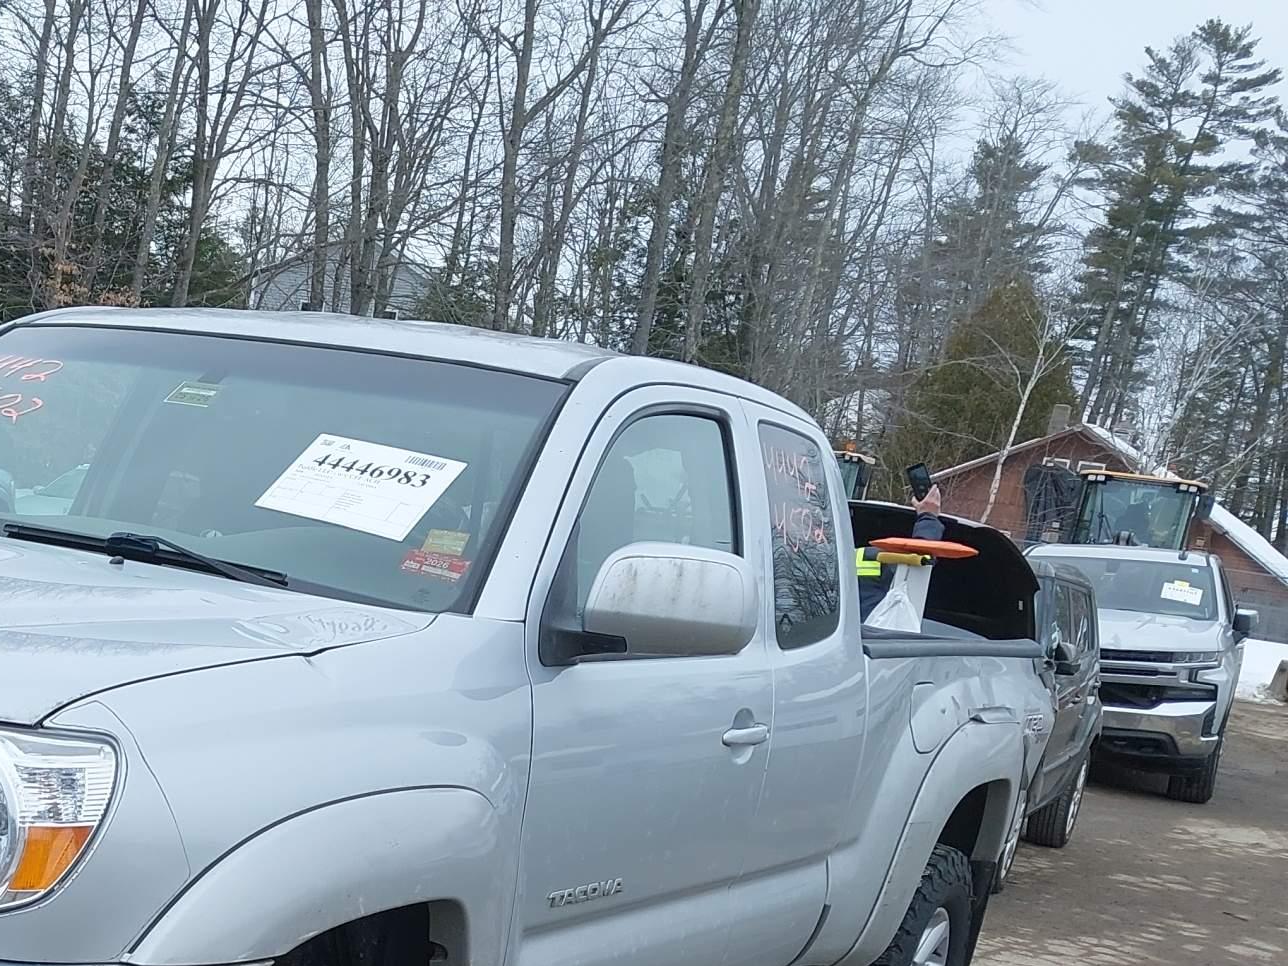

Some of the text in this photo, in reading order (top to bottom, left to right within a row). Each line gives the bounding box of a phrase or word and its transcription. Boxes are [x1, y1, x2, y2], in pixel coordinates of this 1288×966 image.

[312, 453, 432, 488] 44446983
[424, 557, 449, 569] 2026
[548, 877, 624, 908] TACOMA
